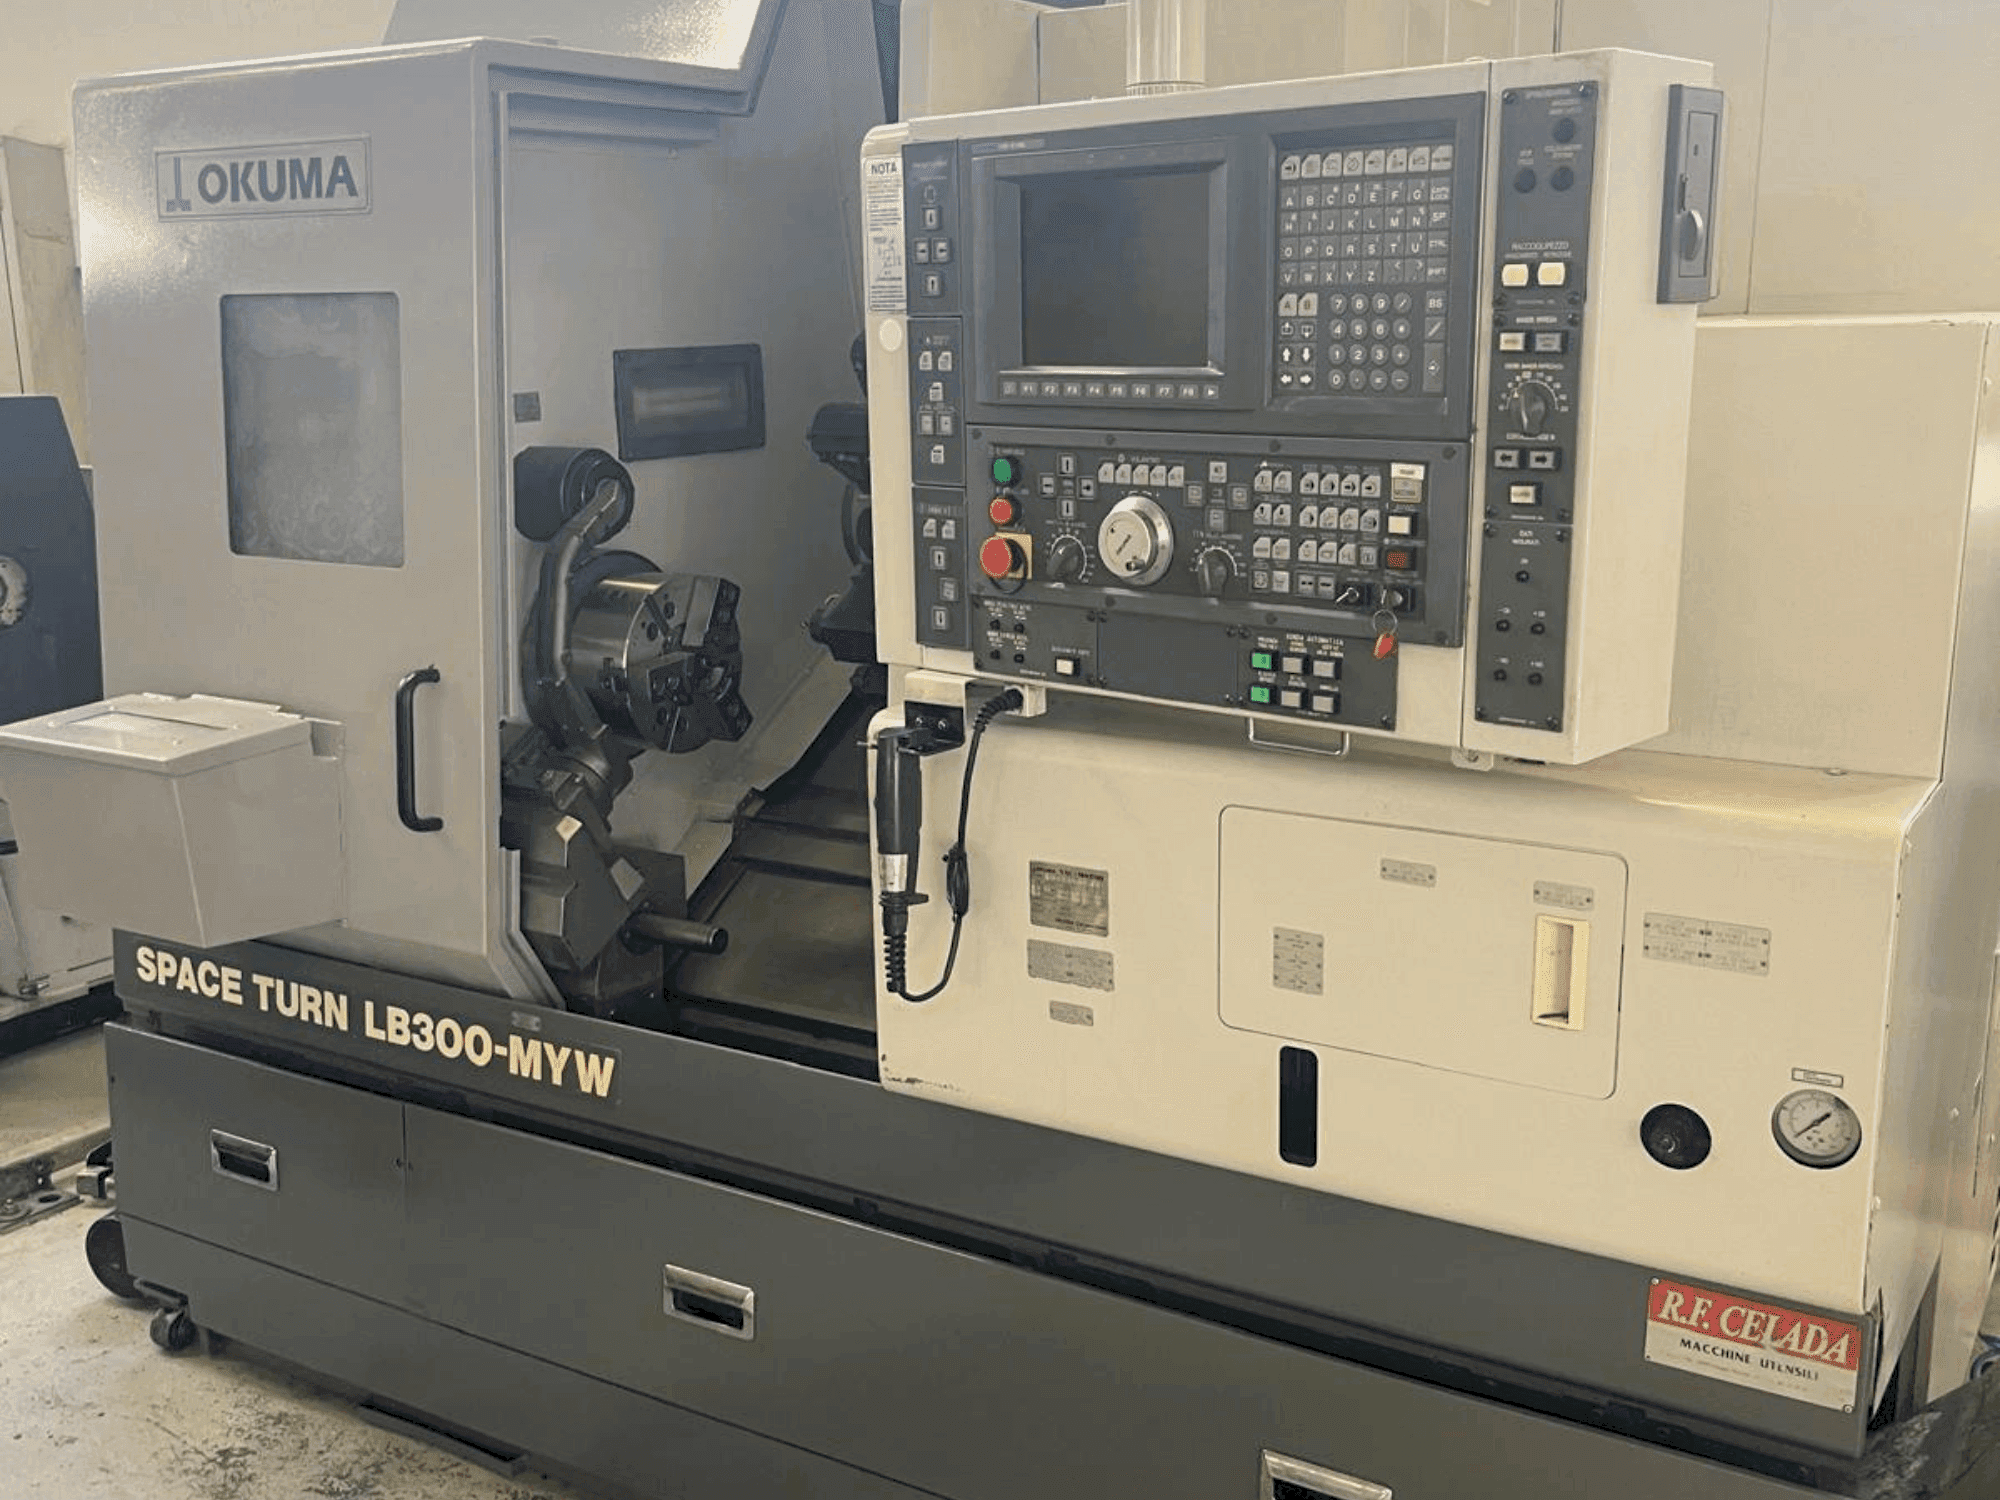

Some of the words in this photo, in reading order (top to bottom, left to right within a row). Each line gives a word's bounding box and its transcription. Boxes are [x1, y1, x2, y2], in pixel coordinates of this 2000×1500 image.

[871, 162, 897, 174] NOTA
[198, 155, 359, 204] OKUMA
[1286, 197, 1293, 206] A
[1306, 195, 1314, 206] B
[1326, 194, 1334, 205] C
[1348, 193, 1356, 204] D
[1369, 192, 1377, 202] E
[1391, 190, 1399, 201] F
[1413, 189, 1421, 200] G
[1285, 222, 1293, 230] H
[1308, 222, 1311, 231] I
[1327, 220, 1334, 230] J
[1348, 220, 1354, 229] K
[1369, 218, 1376, 228] L
[1390, 216, 1399, 227] M
[1412, 216, 1421, 226] N
[1432, 212, 1447, 222] SP
[1368, 244, 1376, 255] S
[1390, 243, 1397, 253] T
[1411, 243, 1419, 253] U
[1367, 270, 1375, 282] Z
[1335, 299, 1343, 309] 7
[1356, 299, 1364, 309] 8
[1377, 298, 1385, 309] 9
[1334, 324, 1342, 334] 4
[1355, 324, 1363, 335] 5
[1376, 324, 1384, 334] 6
[1335, 350, 1340, 360] 1
[1354, 350, 1362, 360] 2
[1376, 349, 1384, 360] 3
[1044, 385, 1055, 393] F2
[1067, 386, 1077, 394] F3
[1112, 387, 1123, 395] F5
[1135, 387, 1146, 396] F6
[1159, 387, 1170, 396] F7
[1183, 388, 1194, 397] F8
[136, 945, 243, 1006] SPACE
[251, 973, 348, 1031] TURN
[364, 1000, 614, 1098] LB300-MYW
[1658, 1289, 1714, 1330] R.F.
[1719, 1305, 1850, 1364] CELADA
[1680, 1338, 1750, 1364] MACCHINE
